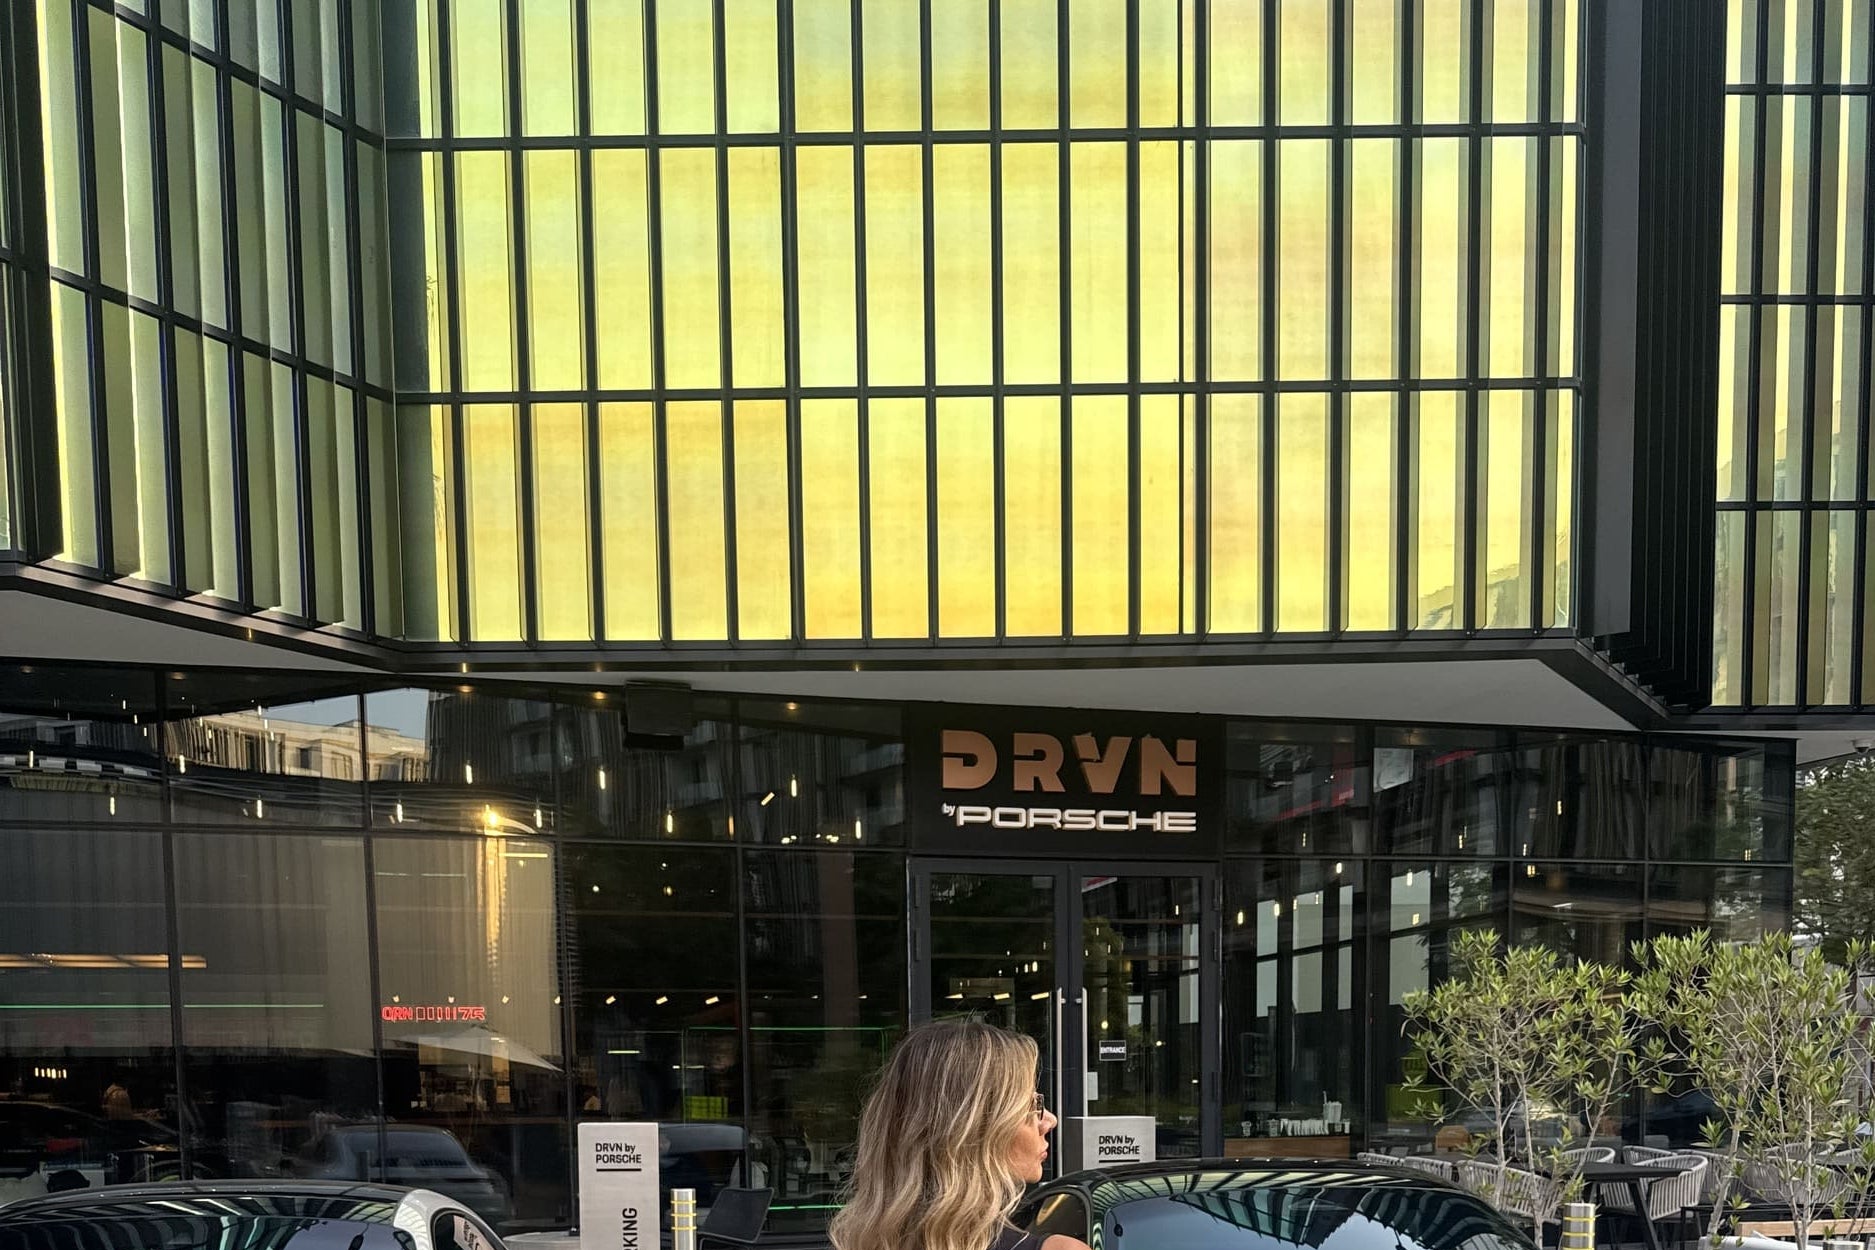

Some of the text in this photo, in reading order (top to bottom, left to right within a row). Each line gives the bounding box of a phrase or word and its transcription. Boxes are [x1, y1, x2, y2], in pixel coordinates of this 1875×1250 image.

[940, 730, 1197, 796] DRVN
[941, 803, 1197, 832] by PORSCHE
[1099, 1135, 1135, 1146] DRVN by
[595, 1142, 636, 1155] DRVN by
[1099, 1145, 1140, 1155] PORSCHE
[595, 1154, 642, 1164] PORSCHE
